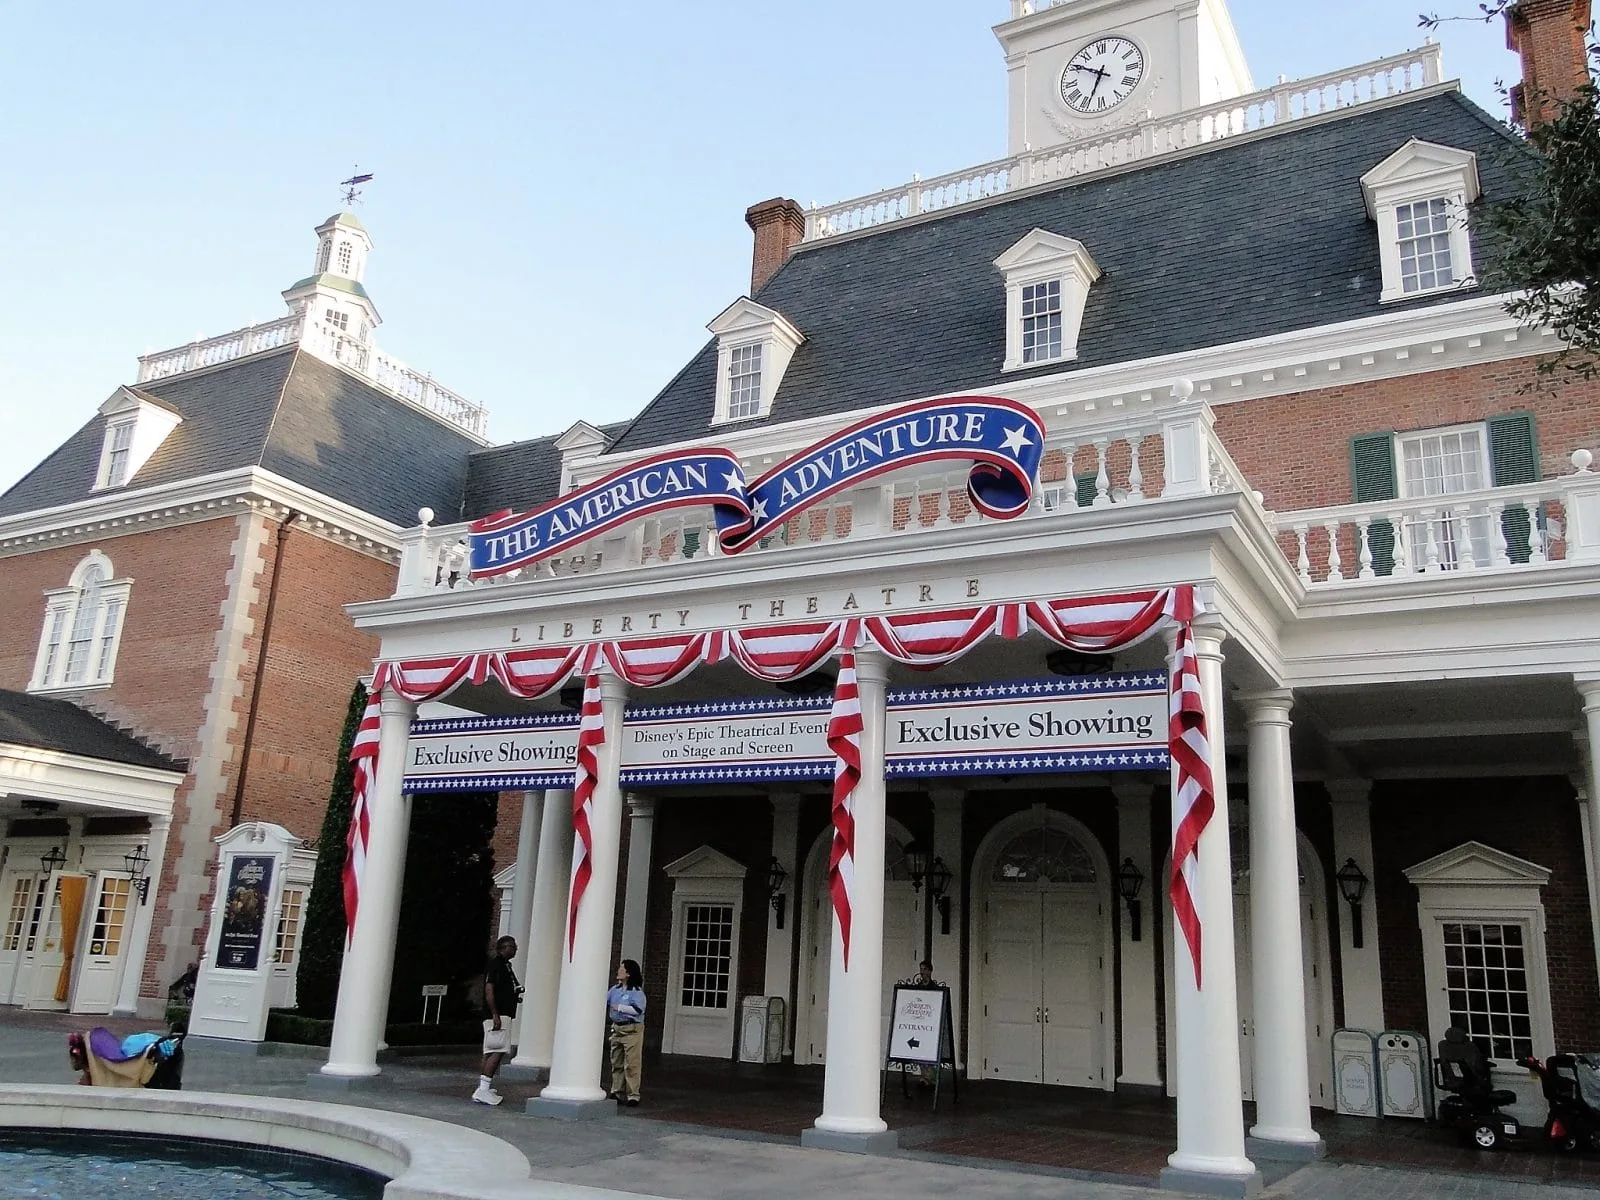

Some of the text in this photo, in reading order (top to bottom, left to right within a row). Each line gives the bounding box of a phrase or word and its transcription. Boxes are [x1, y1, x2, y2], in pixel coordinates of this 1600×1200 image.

[485, 413, 986, 564] THE AMERICAN ADVENTURE
[511, 578, 980, 643] LIBERTY THEATRE
[634, 721, 829, 744] Disney's Epic Theatrical Event
[897, 708, 1154, 745] Exclusive Showing
[413, 740, 577, 766] Exclusive Showing
[662, 742, 794, 760] on Stage and Screen
[898, 1023, 933, 1031] ENTRANCE
